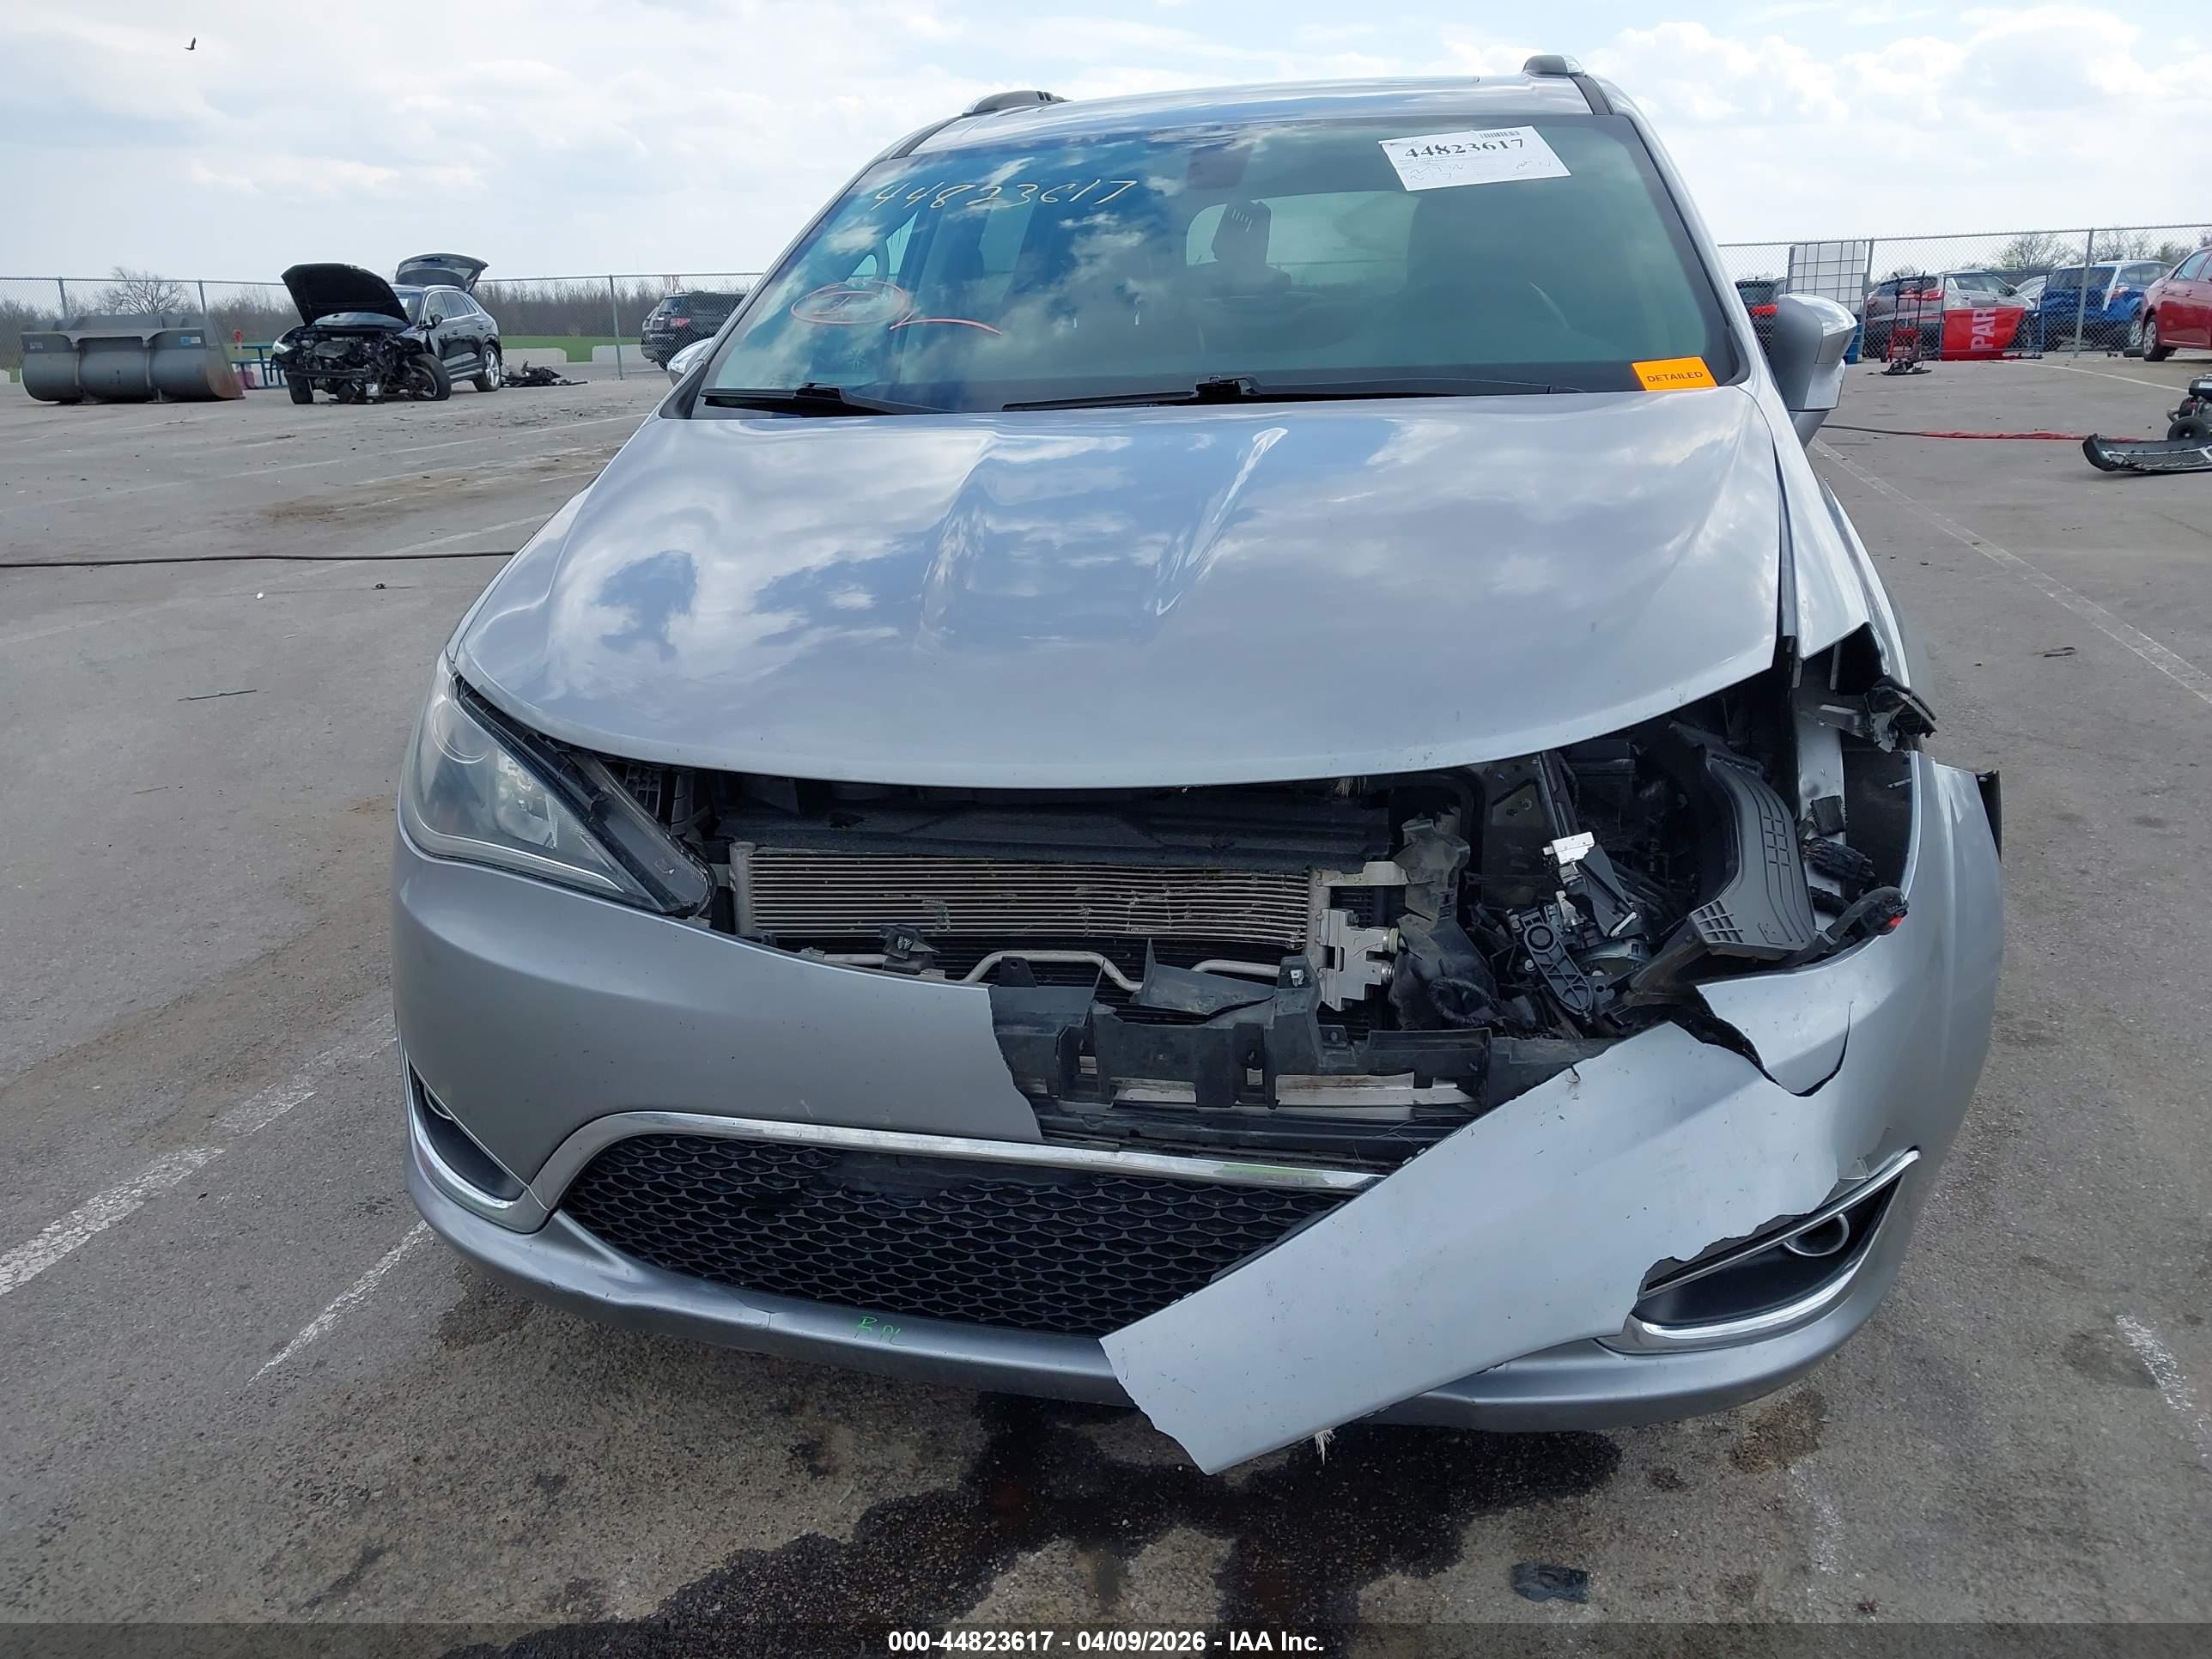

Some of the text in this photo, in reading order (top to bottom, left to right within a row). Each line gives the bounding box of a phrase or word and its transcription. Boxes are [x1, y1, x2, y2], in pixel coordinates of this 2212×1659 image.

[1405, 138, 1524, 158] 44823617
[868, 178, 1139, 212] 44823617
[1646, 371, 1704, 383] DETAILED
